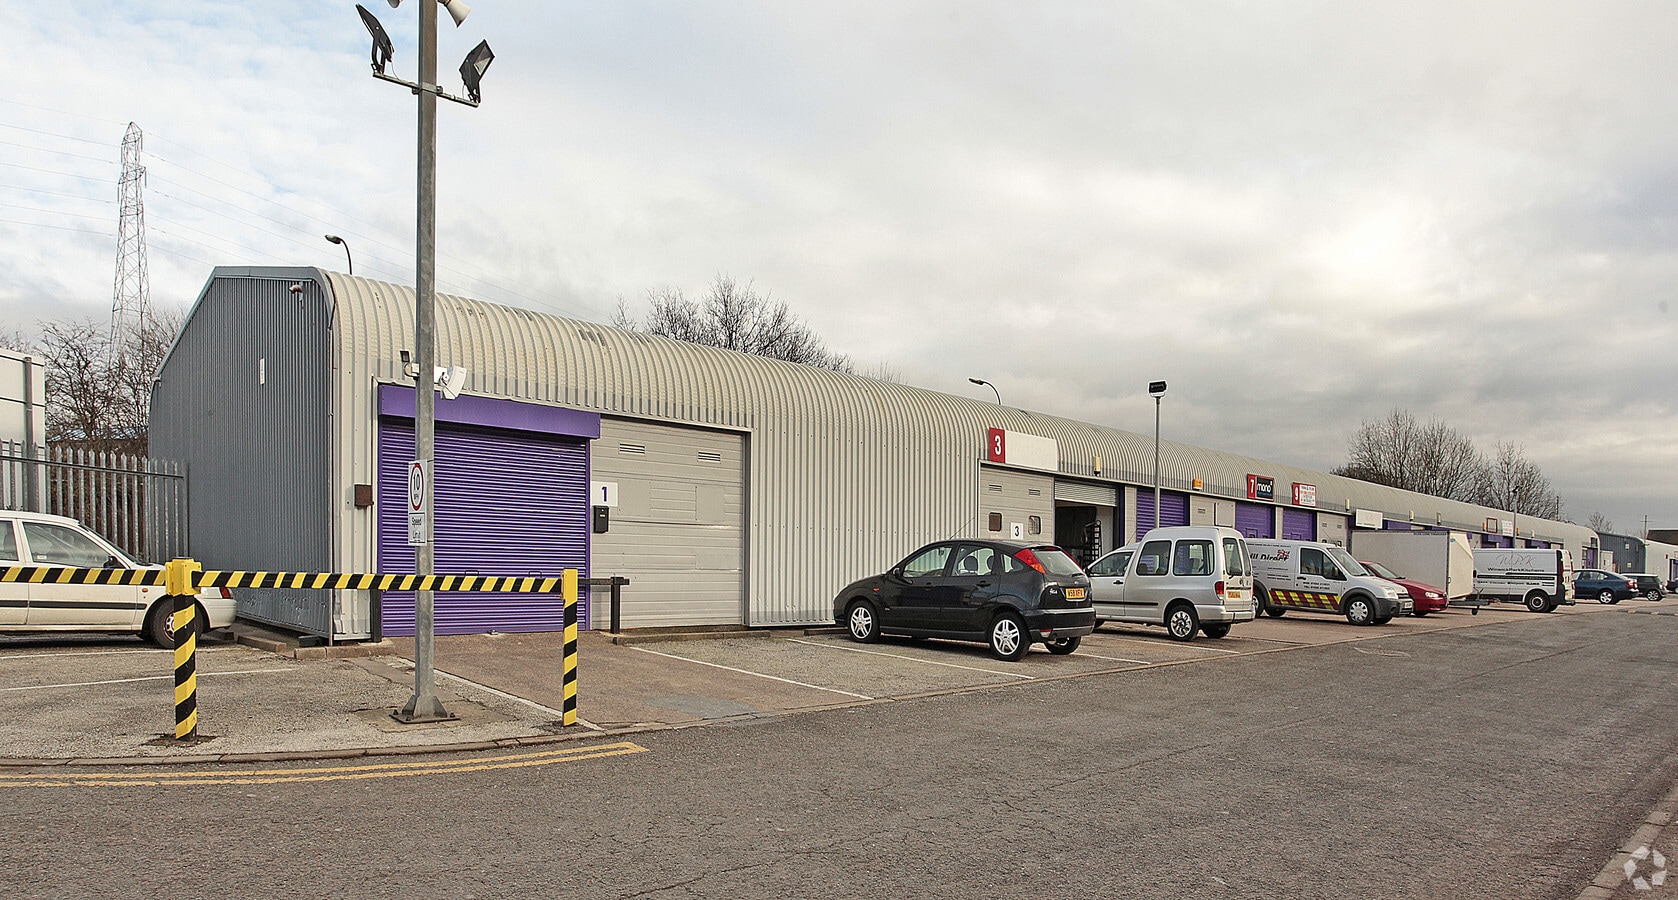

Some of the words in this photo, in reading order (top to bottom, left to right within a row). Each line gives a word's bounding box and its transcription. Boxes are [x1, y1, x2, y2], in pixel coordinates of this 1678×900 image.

[994, 435, 1002, 455] 3
[413, 474, 421, 491] 10
[1250, 479, 1255, 494] 7
[1257, 483, 1271, 492] mono
[601, 486, 607, 502] 1
[1294, 486, 1299, 501] 9
[1014, 525, 1020, 537] 3
